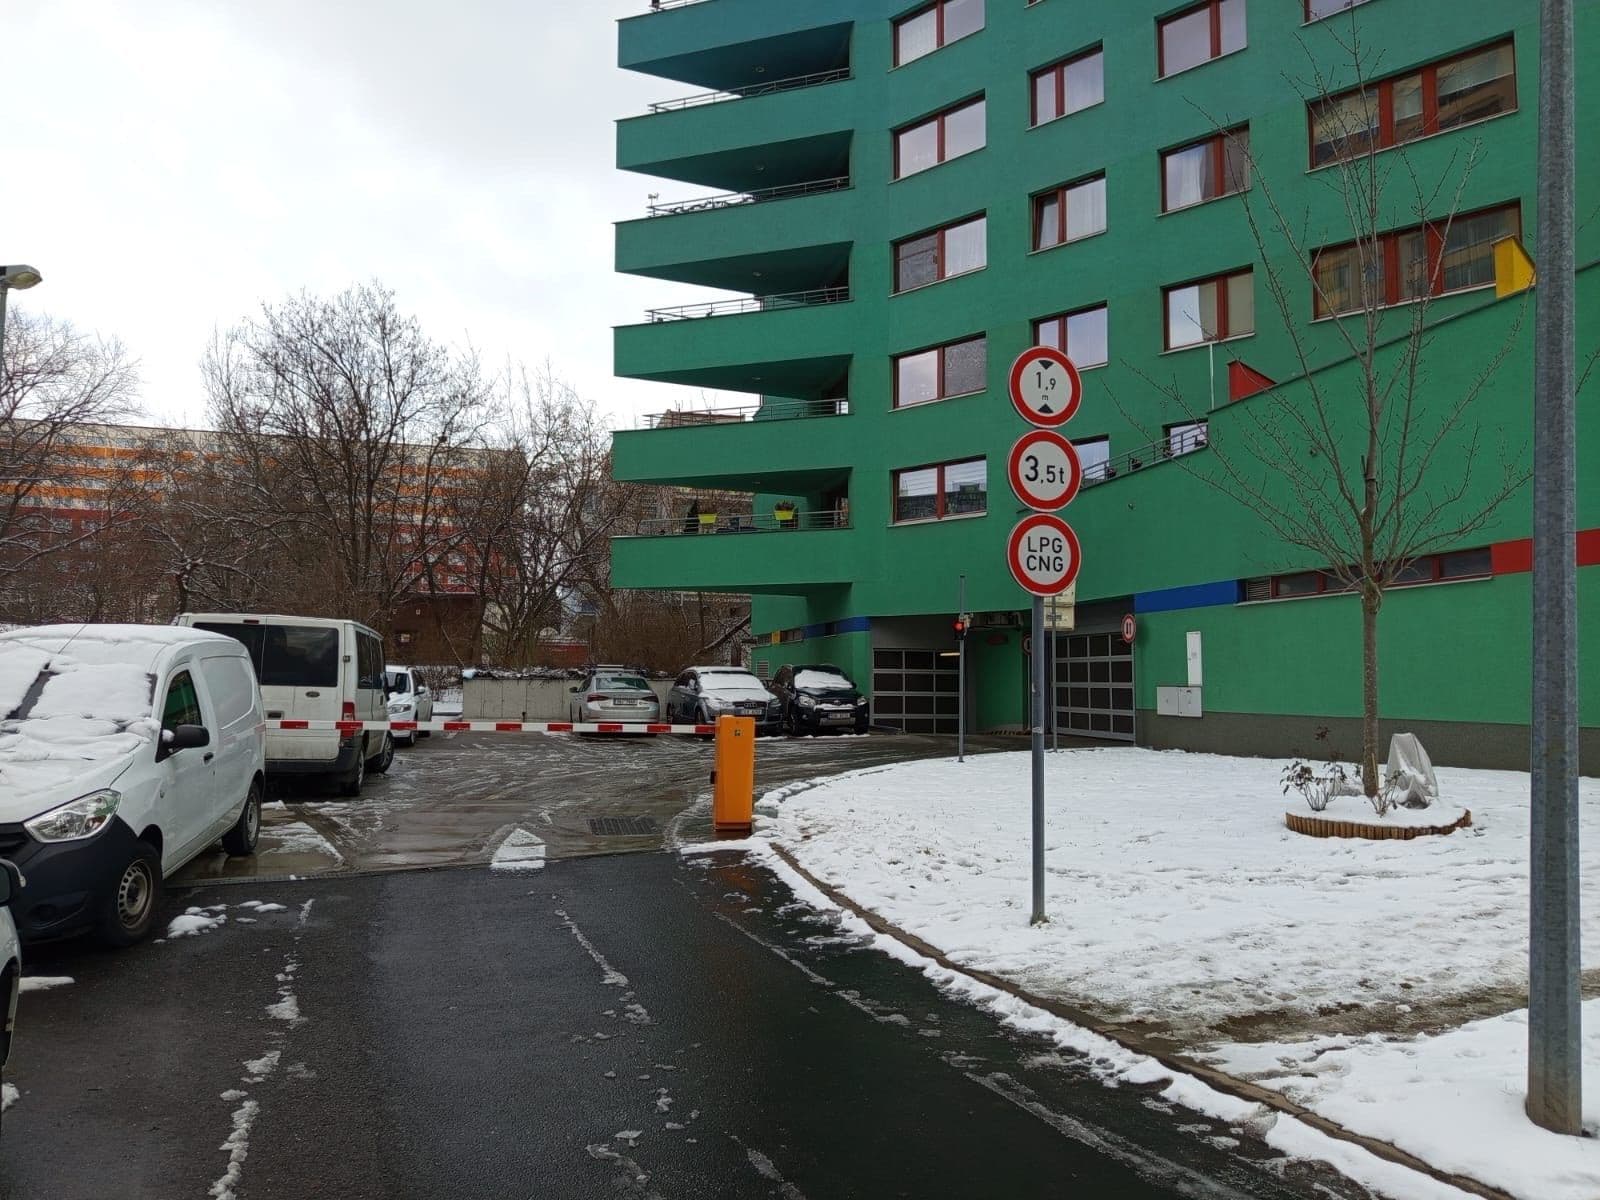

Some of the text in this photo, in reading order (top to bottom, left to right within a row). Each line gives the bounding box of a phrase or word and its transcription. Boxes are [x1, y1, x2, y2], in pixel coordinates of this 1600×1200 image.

[1035, 371, 1057, 391] 1,9
[1027, 536, 1063, 554] LPG
[1026, 554, 1064, 572] CNG
